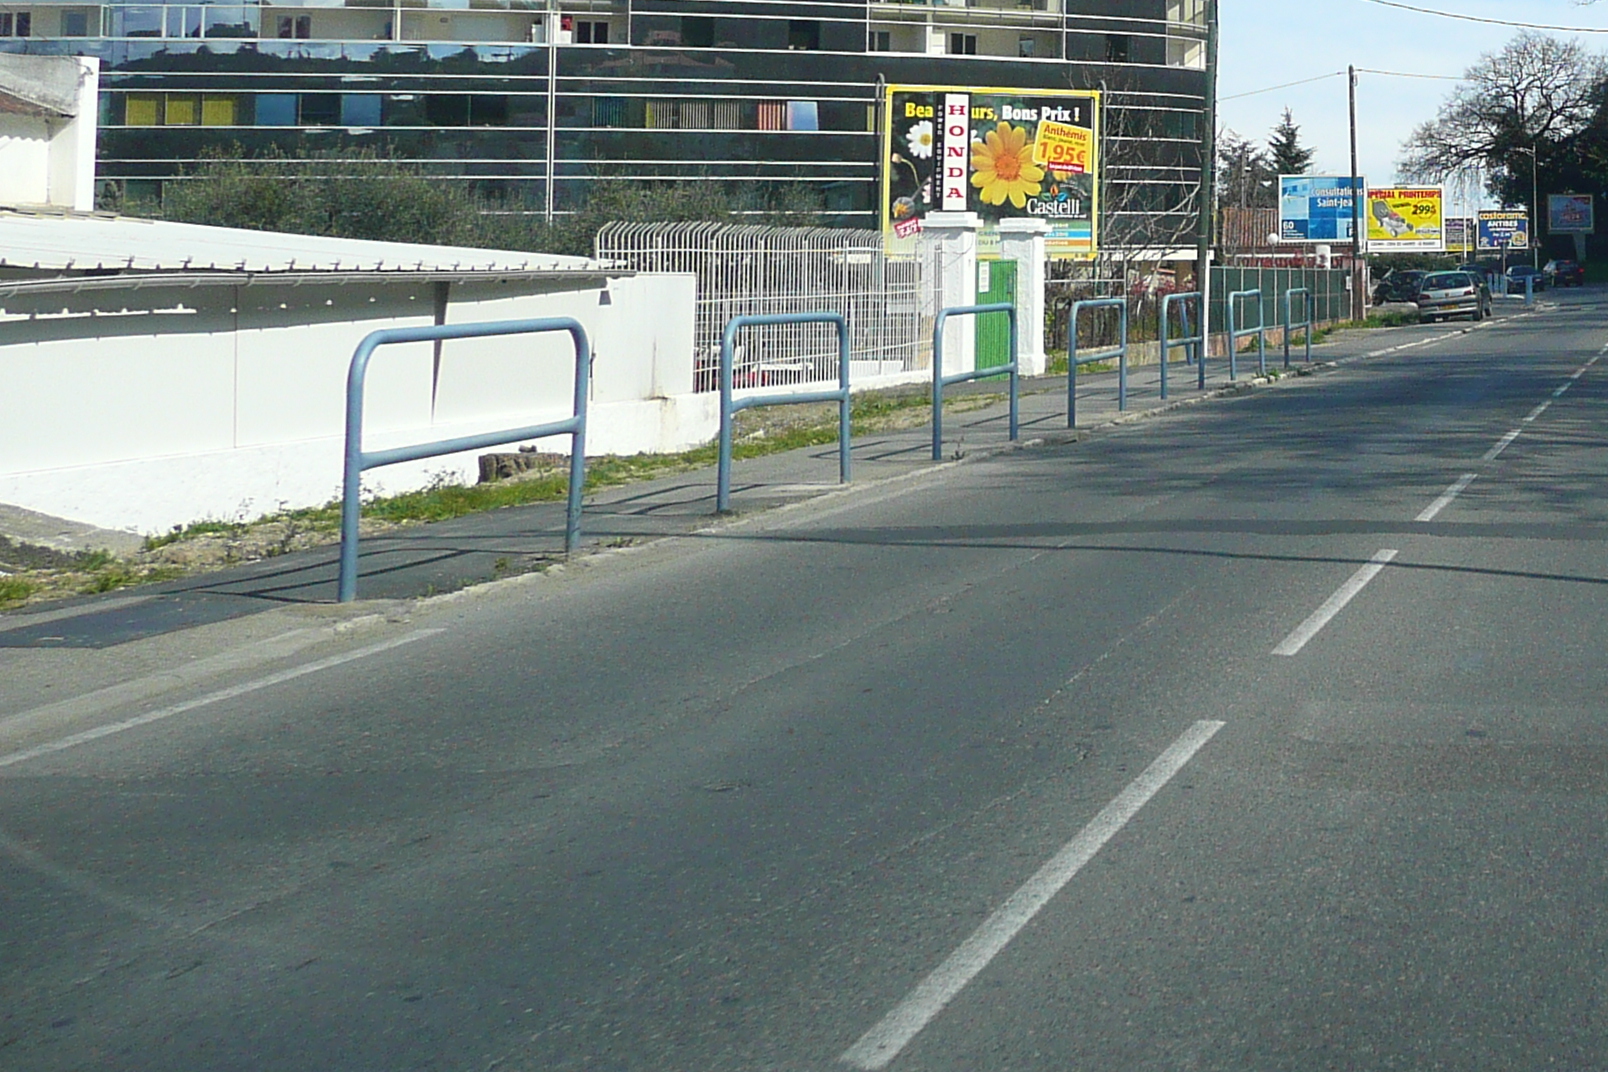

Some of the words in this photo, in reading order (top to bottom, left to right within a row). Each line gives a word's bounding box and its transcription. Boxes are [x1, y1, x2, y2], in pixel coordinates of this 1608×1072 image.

[905, 102, 933, 118] Bea
[1001, 105, 1038, 121] Bons
[1041, 106, 1071, 122] Prix
[946, 104, 966, 198] HONDA
[1026, 197, 1080, 215] Castelli
[1283, 221, 1294, 230] 60
